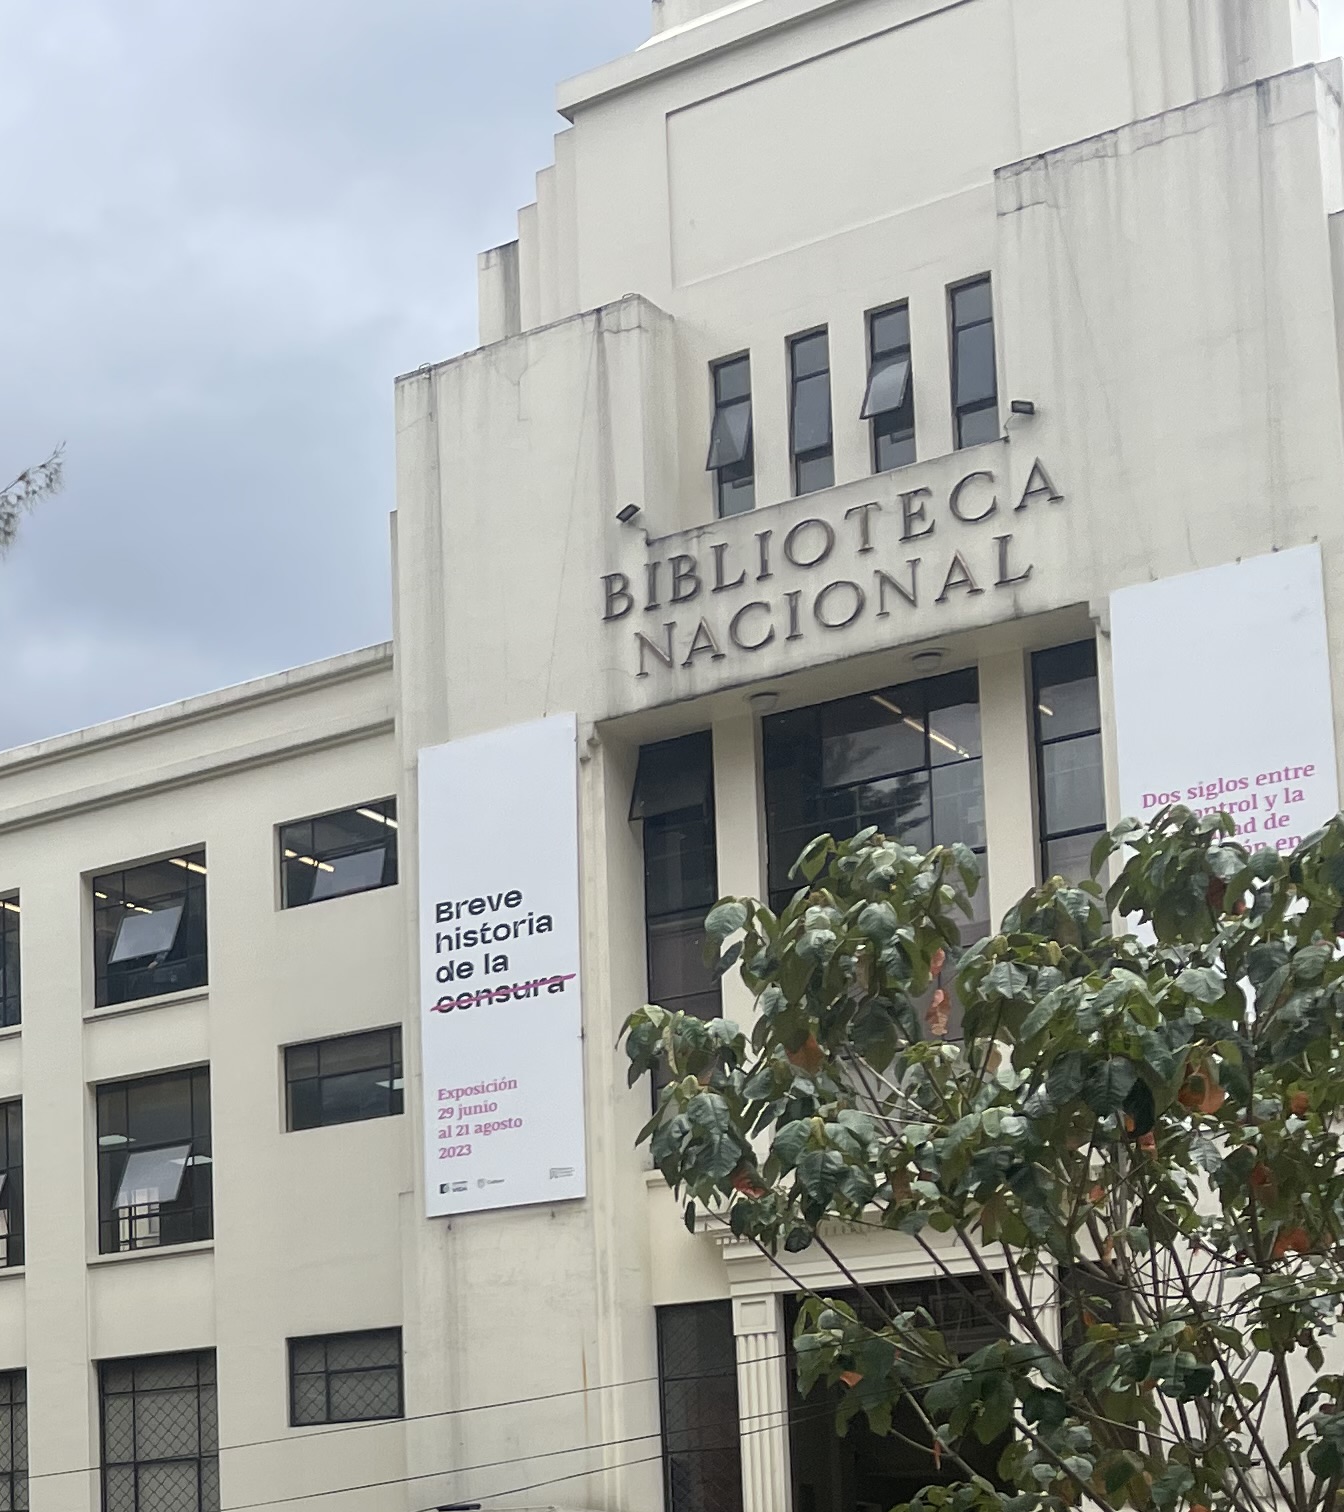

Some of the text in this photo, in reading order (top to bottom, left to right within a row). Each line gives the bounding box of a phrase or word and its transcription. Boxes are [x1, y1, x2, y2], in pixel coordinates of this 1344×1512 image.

[600, 457, 1065, 622] BIBLIOTECA
[634, 535, 1034, 678] NACIONAL
[1142, 764, 1316, 809] Dos siglos entre
[1186, 787, 1305, 820] ontrol y la
[1263, 813, 1291, 832] de
[435, 889, 523, 923] Breve
[435, 911, 553, 954] historia
[436, 953, 509, 983] de la
[436, 975, 565, 1013] censura
[438, 1076, 518, 1101] Exposición
[438, 1100, 498, 1121] 29 junio
[438, 1118, 523, 1139] al 21 agosto
[438, 1144, 472, 1160] 2023
